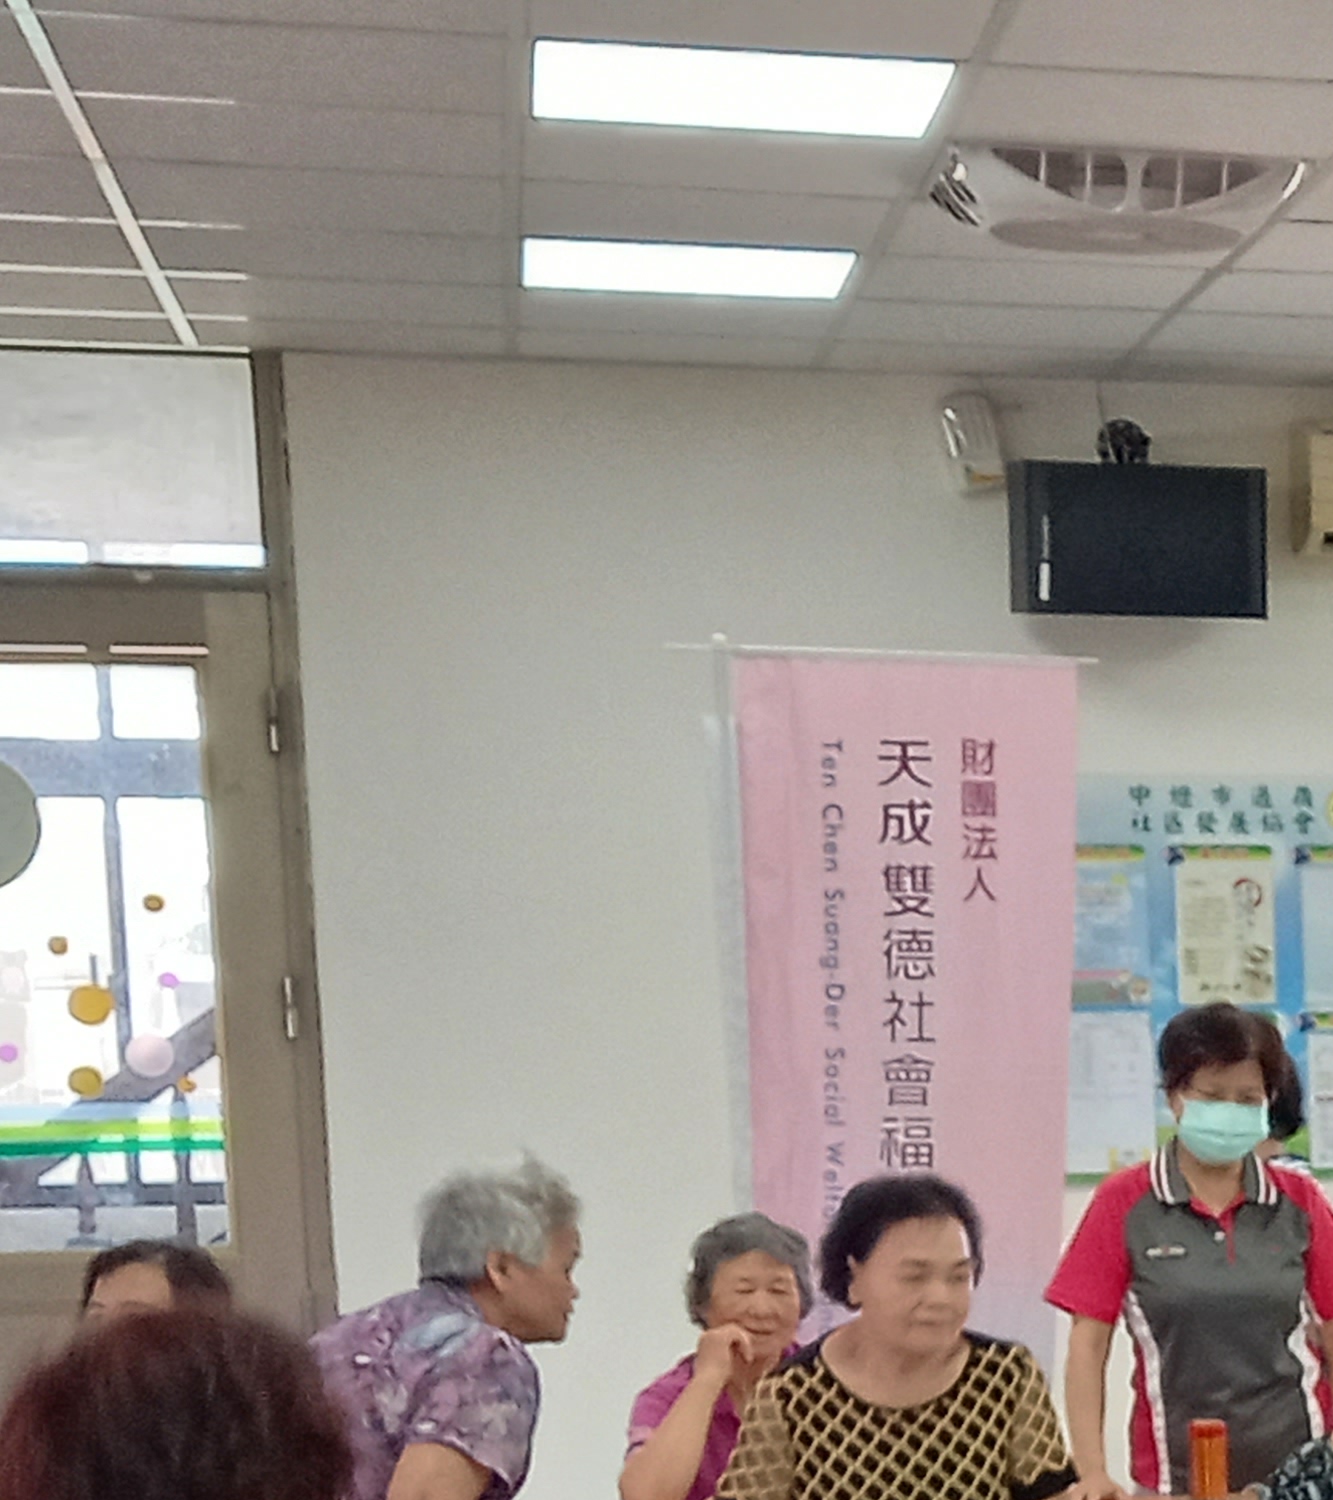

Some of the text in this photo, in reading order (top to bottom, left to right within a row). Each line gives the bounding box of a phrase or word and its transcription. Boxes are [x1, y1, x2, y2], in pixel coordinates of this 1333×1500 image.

[821, 739, 844, 788] Ten
[822, 803, 844, 872] Chen
[960, 737, 999, 902] 財團法人
[878, 738, 936, 1169] 天成雙德社會福
[823, 1047, 846, 1127] Social
